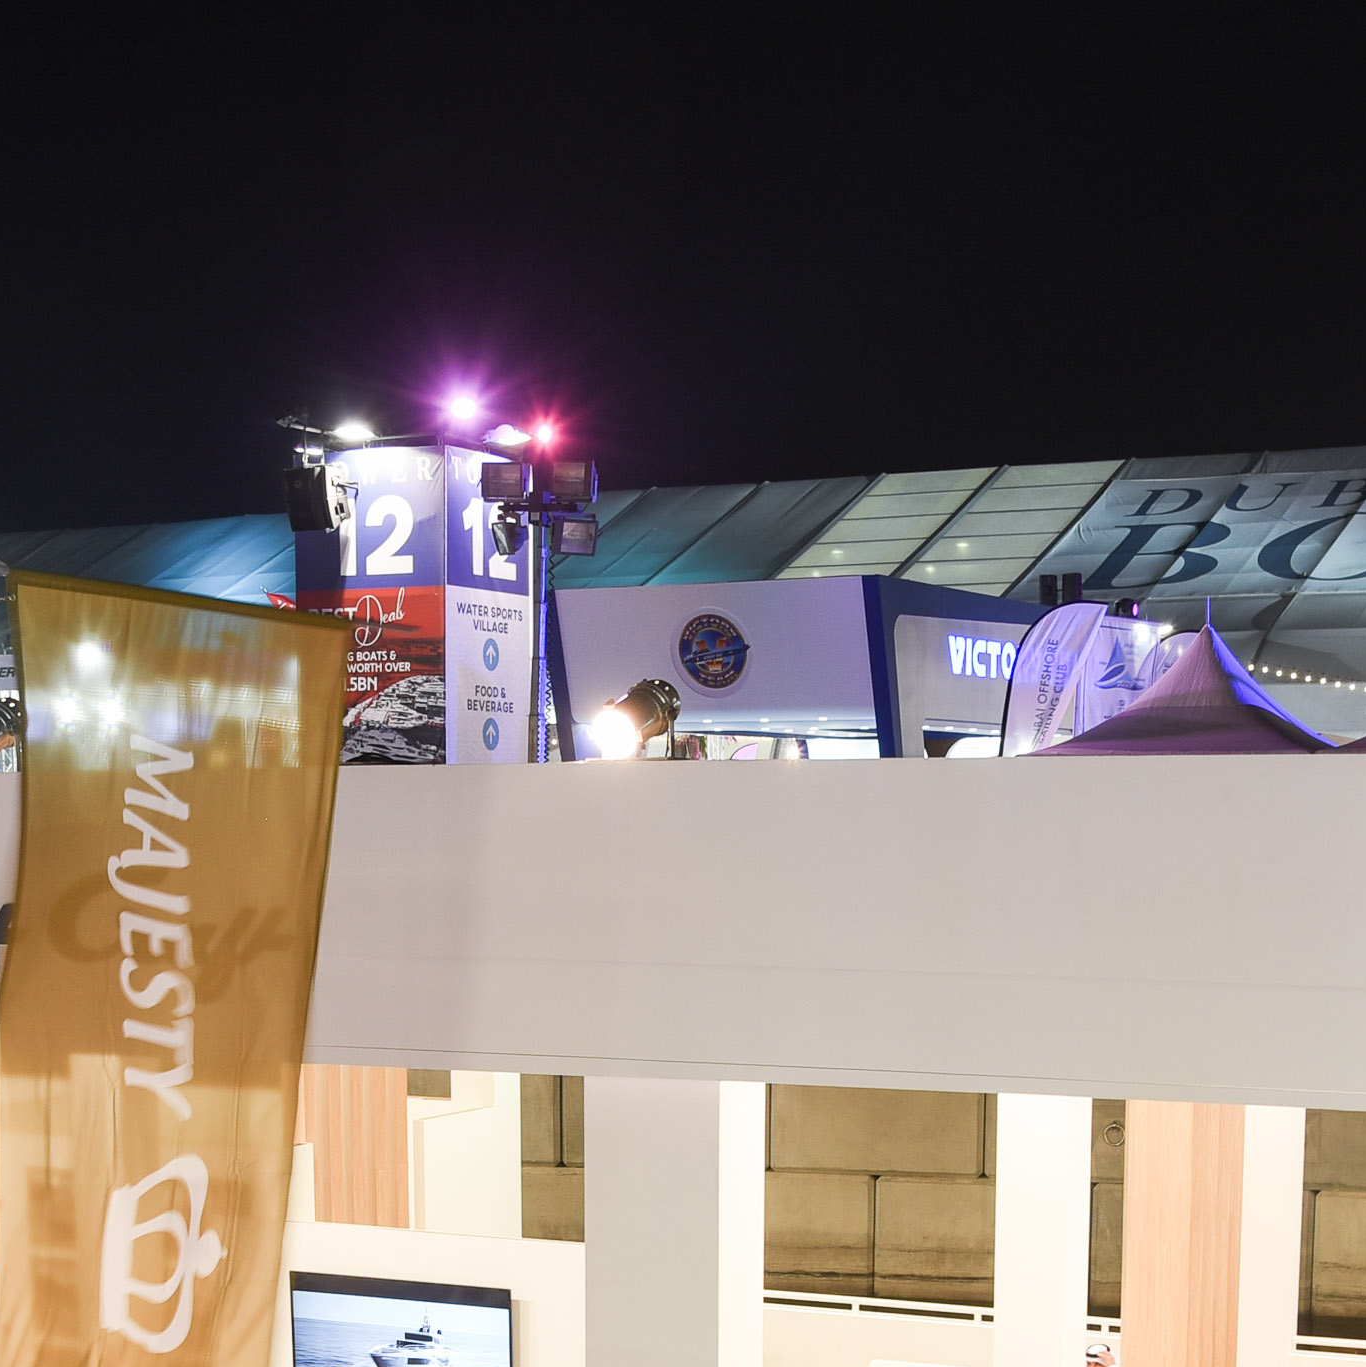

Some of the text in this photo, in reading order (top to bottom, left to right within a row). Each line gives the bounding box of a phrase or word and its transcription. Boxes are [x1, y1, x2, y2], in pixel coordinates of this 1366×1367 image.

[457, 602, 523, 621] WATER SPORTS
[473, 619, 509, 634] VILLAGE
[357, 651, 388, 662] BOATS
[389, 651, 397, 661] &
[347, 662, 411, 673] WORTH OVER
[1038, 638, 1059, 705] OFFSHORE
[1053, 664, 1068, 694] CLUB
[475, 685, 506, 698] FOOD &
[467, 699, 514, 713] BEVERAGE
[107, 734, 195, 1122] MAJESTY
